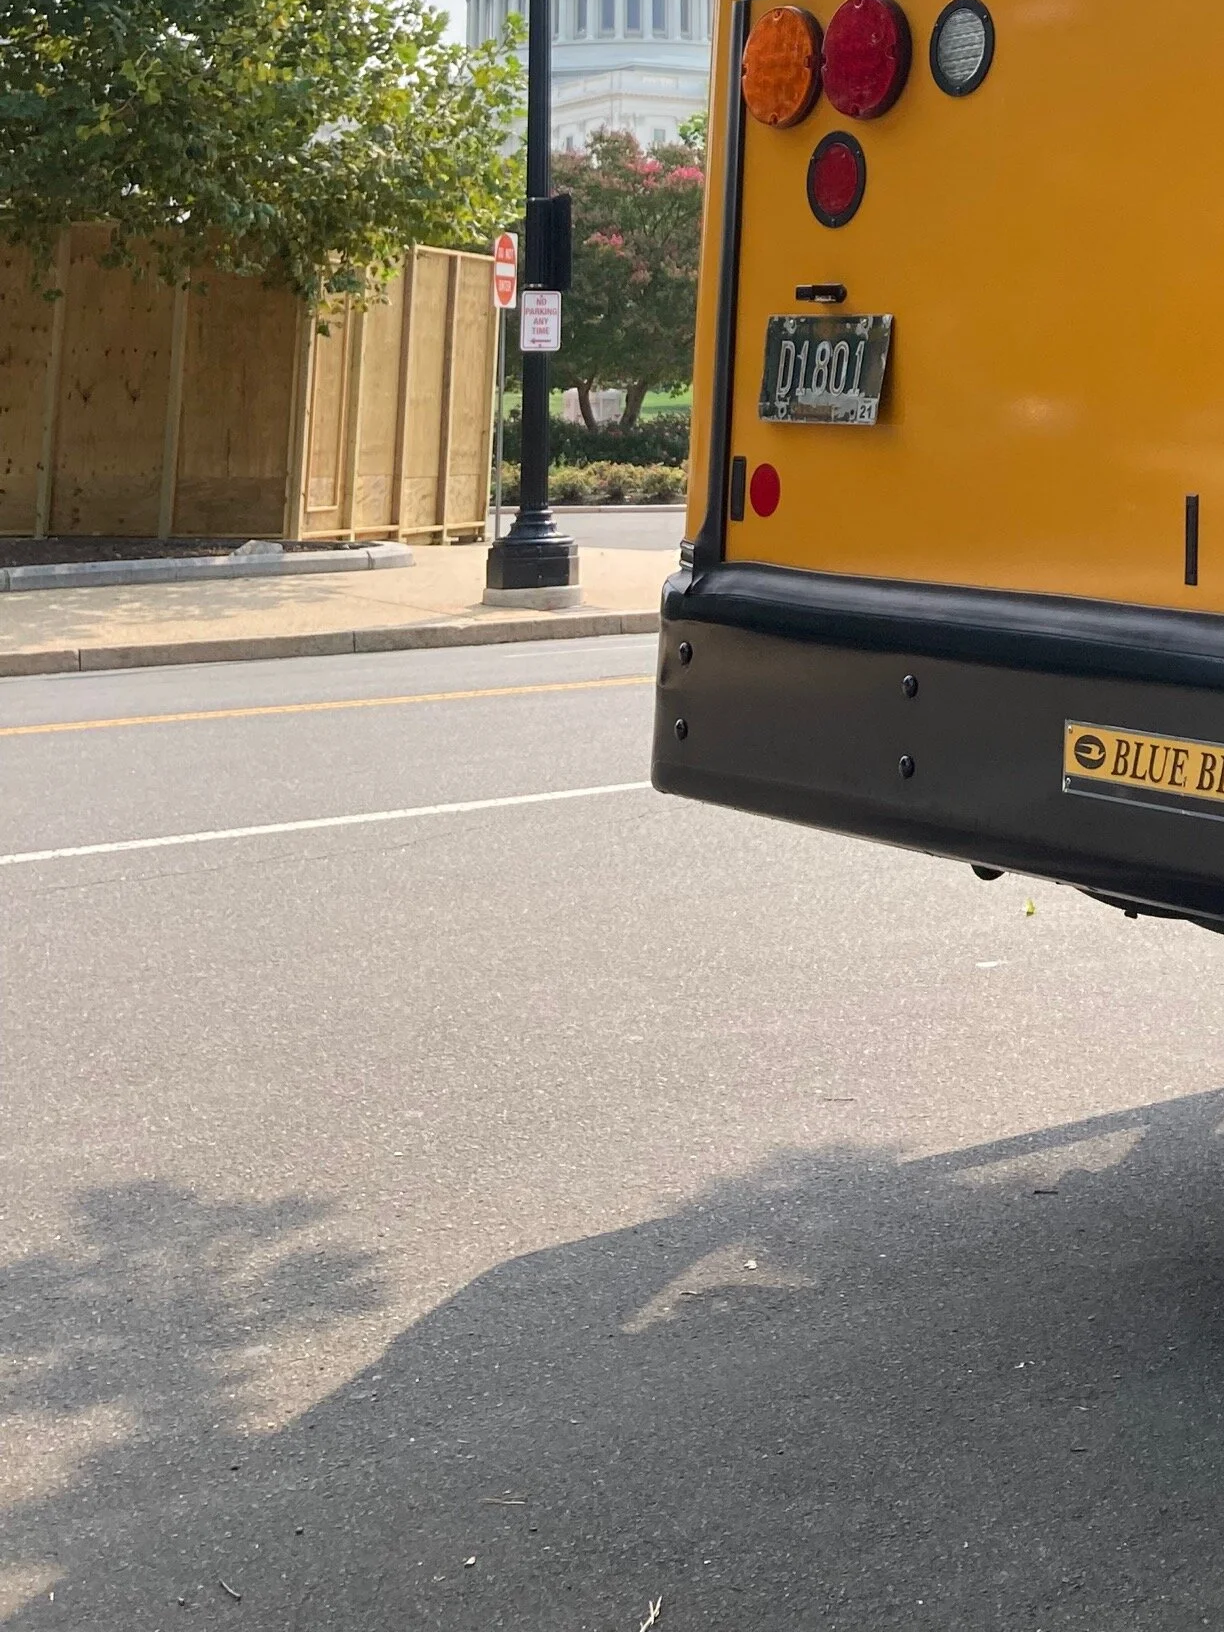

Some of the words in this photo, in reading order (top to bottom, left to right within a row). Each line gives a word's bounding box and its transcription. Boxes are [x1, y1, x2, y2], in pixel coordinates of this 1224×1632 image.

[536, 298, 547, 306] NO
[525, 307, 558, 316] PARKING
[533, 317, 549, 325] ANY
[531, 326, 550, 335] TIME
[776, 340, 865, 397] D1801
[859, 404, 872, 419] 21
[1111, 738, 1189, 786] BLUE
